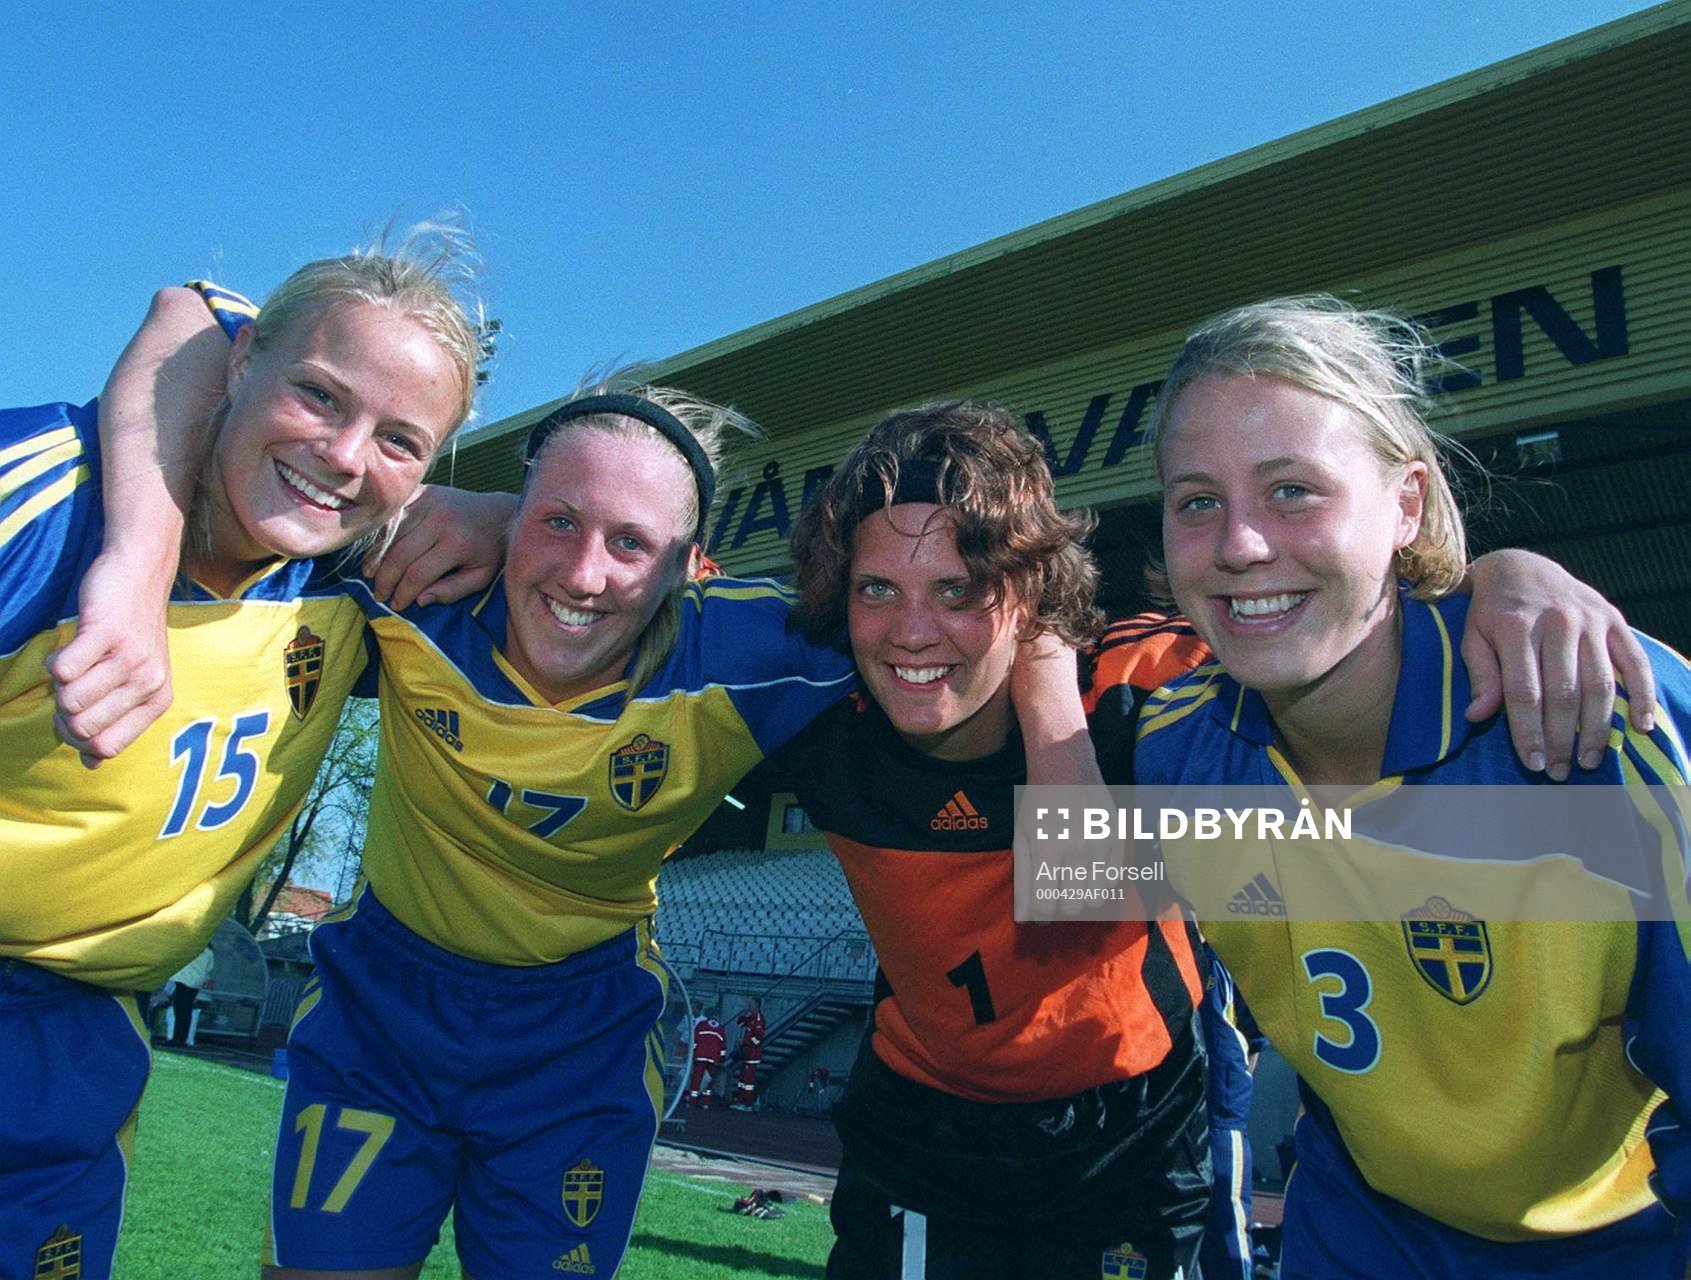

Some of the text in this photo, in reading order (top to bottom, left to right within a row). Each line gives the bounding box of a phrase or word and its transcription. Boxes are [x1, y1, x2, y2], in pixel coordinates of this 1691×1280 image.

[415, 708, 465, 752] adidas
[157, 708, 272, 840] 15
[486, 776, 588, 839] 17
[930, 815, 989, 831] adidas
[1227, 899, 1286, 917] adida
[945, 950, 997, 1025] 1
[1301, 947, 1382, 1075] 3
[290, 1103, 396, 1213] 17
[552, 1258, 596, 1275] adidas
